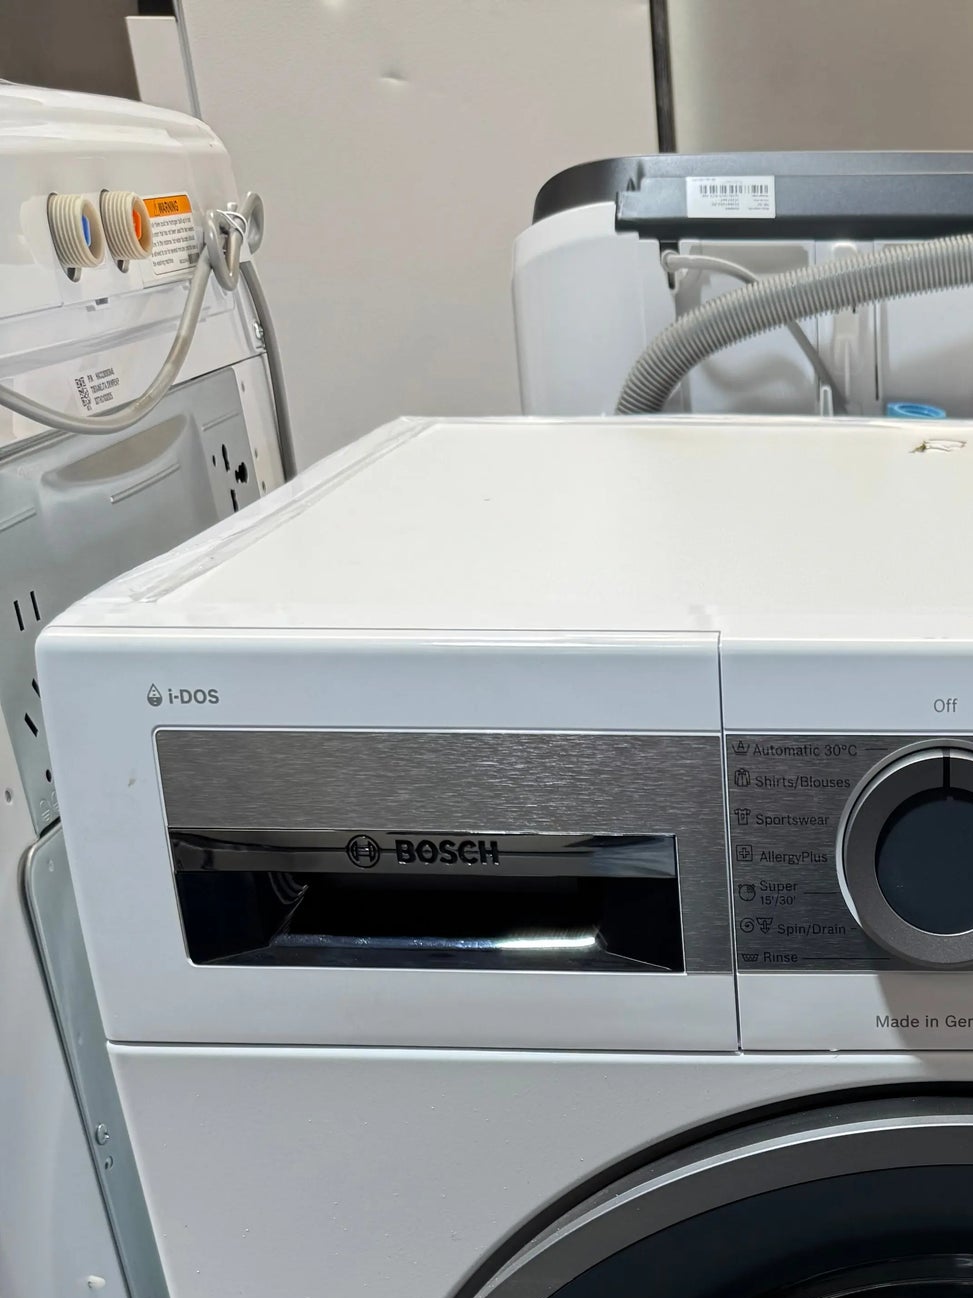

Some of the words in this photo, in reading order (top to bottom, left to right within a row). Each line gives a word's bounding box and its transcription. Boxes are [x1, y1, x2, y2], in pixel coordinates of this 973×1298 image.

[168, 688, 219, 704] i-DOS
[933, 698, 958, 713] Off
[753, 744, 820, 757] Automatic
[824, 744, 857, 757] 30°C
[755, 776, 851, 789] Shirts/Blouses
[756, 814, 830, 826] Sportswear
[395, 839, 500, 865] BOSCH
[760, 851, 828, 865] AllergyPlus
[760, 881, 798, 894] Super
[777, 924, 846, 936] Spin/Drain
[763, 952, 798, 963] Rinse
[876, 1015, 920, 1028] Made
[925, 1015, 939, 1028] in
